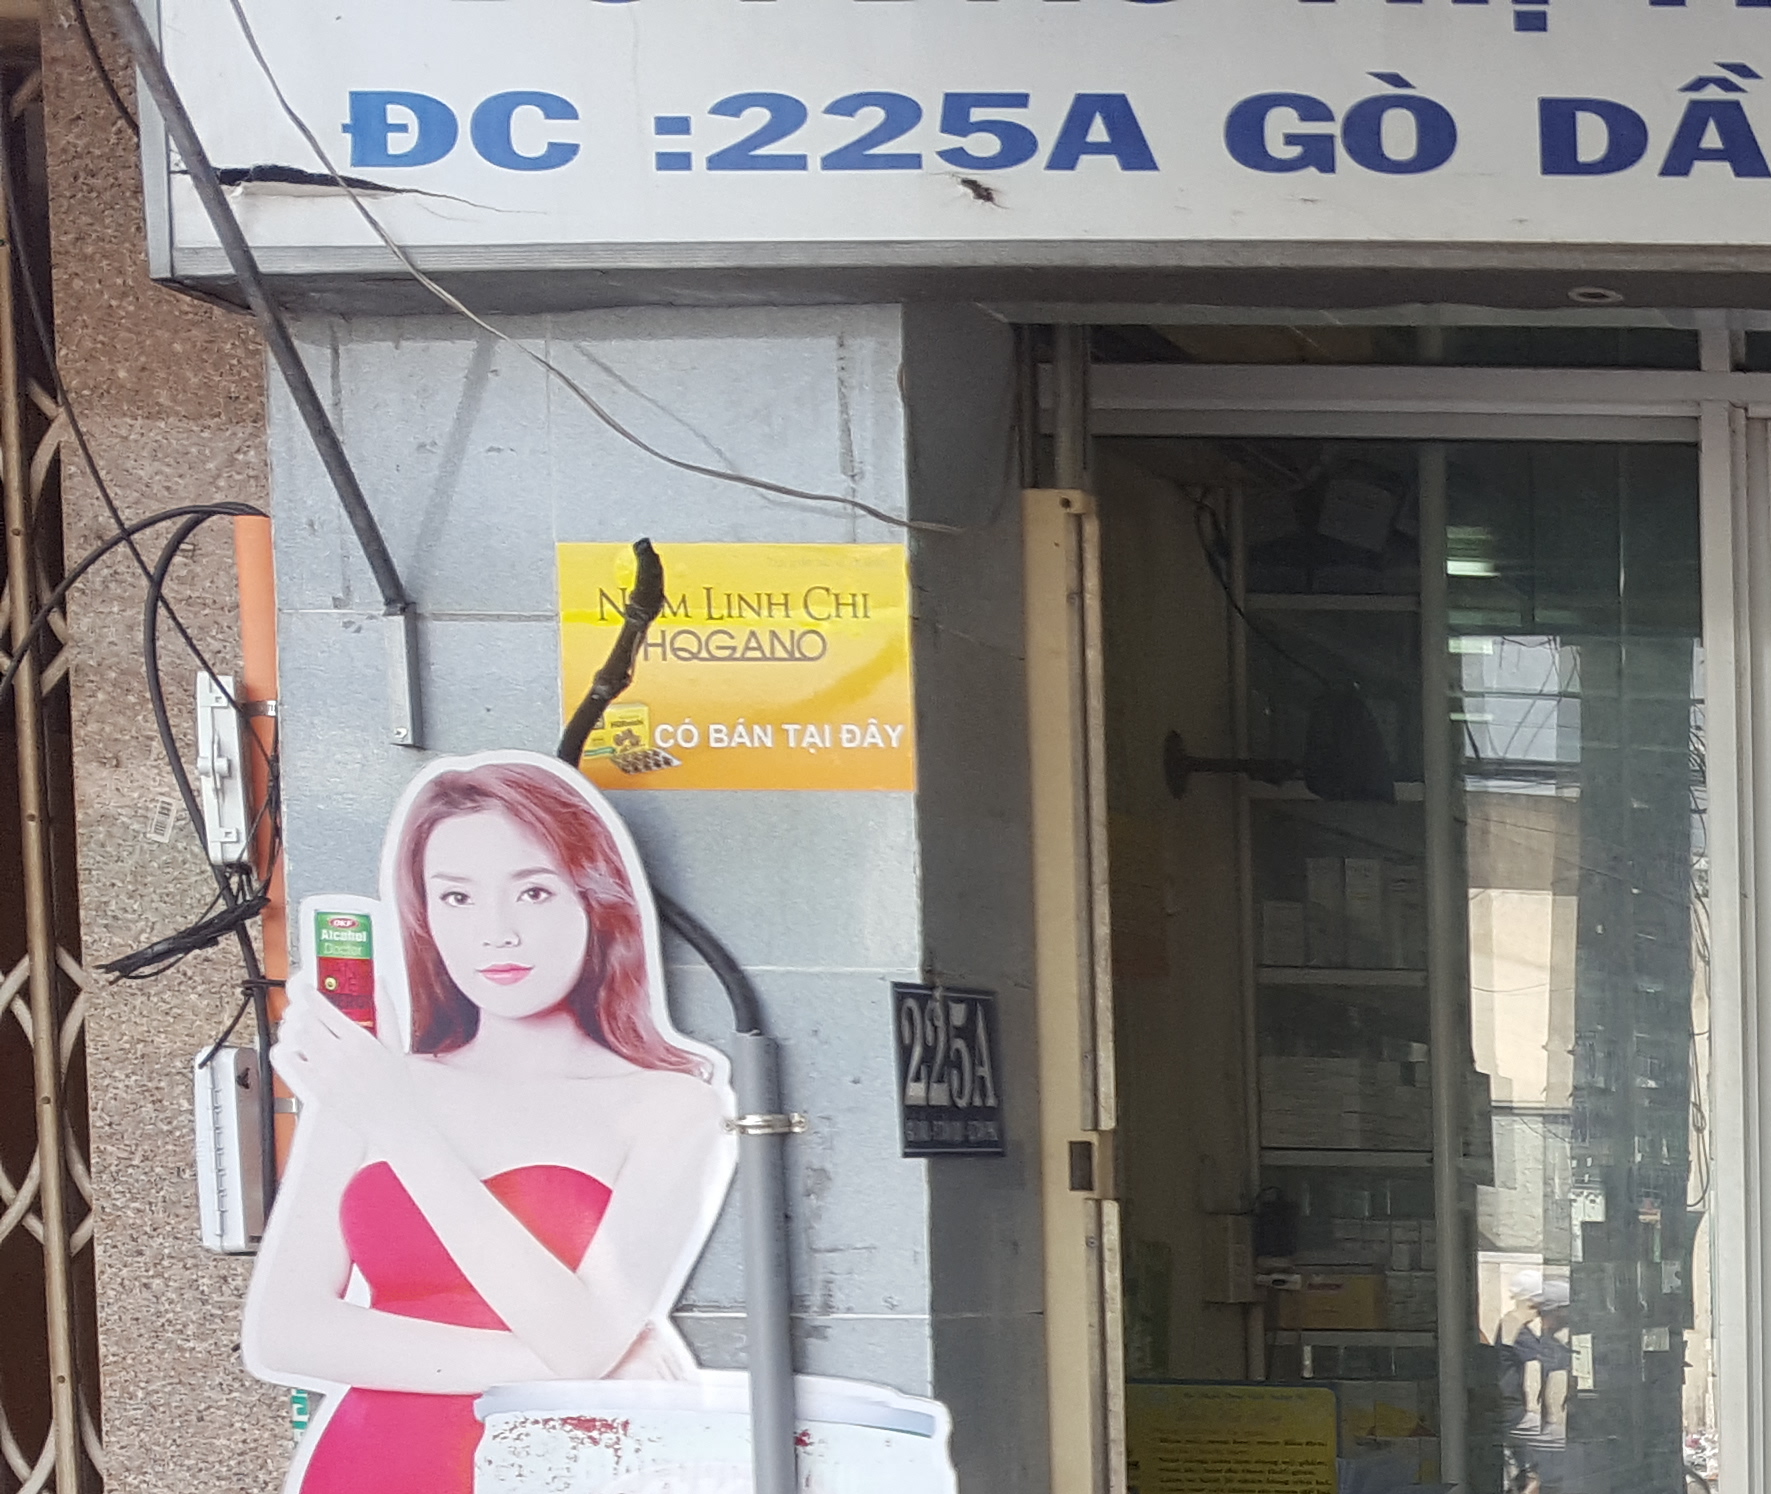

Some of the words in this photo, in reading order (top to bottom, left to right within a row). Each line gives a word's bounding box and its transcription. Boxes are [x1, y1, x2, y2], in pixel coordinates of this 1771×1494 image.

[342, 90, 581, 173] ĐC
[1224, 73, 1457, 175] GÒ
[599, 587, 692, 621] NM
[703, 587, 790, 619] LINH
[803, 586, 870, 620] CHI
[655, 718, 699, 748] CÓ
[709, 718, 773, 748] BÁN
[782, 722, 832, 754] TẠI
[839, 718, 904, 748] ĐÂY
[320, 930, 367, 941] Alcohol
[901, 997, 999, 1109] 225A
